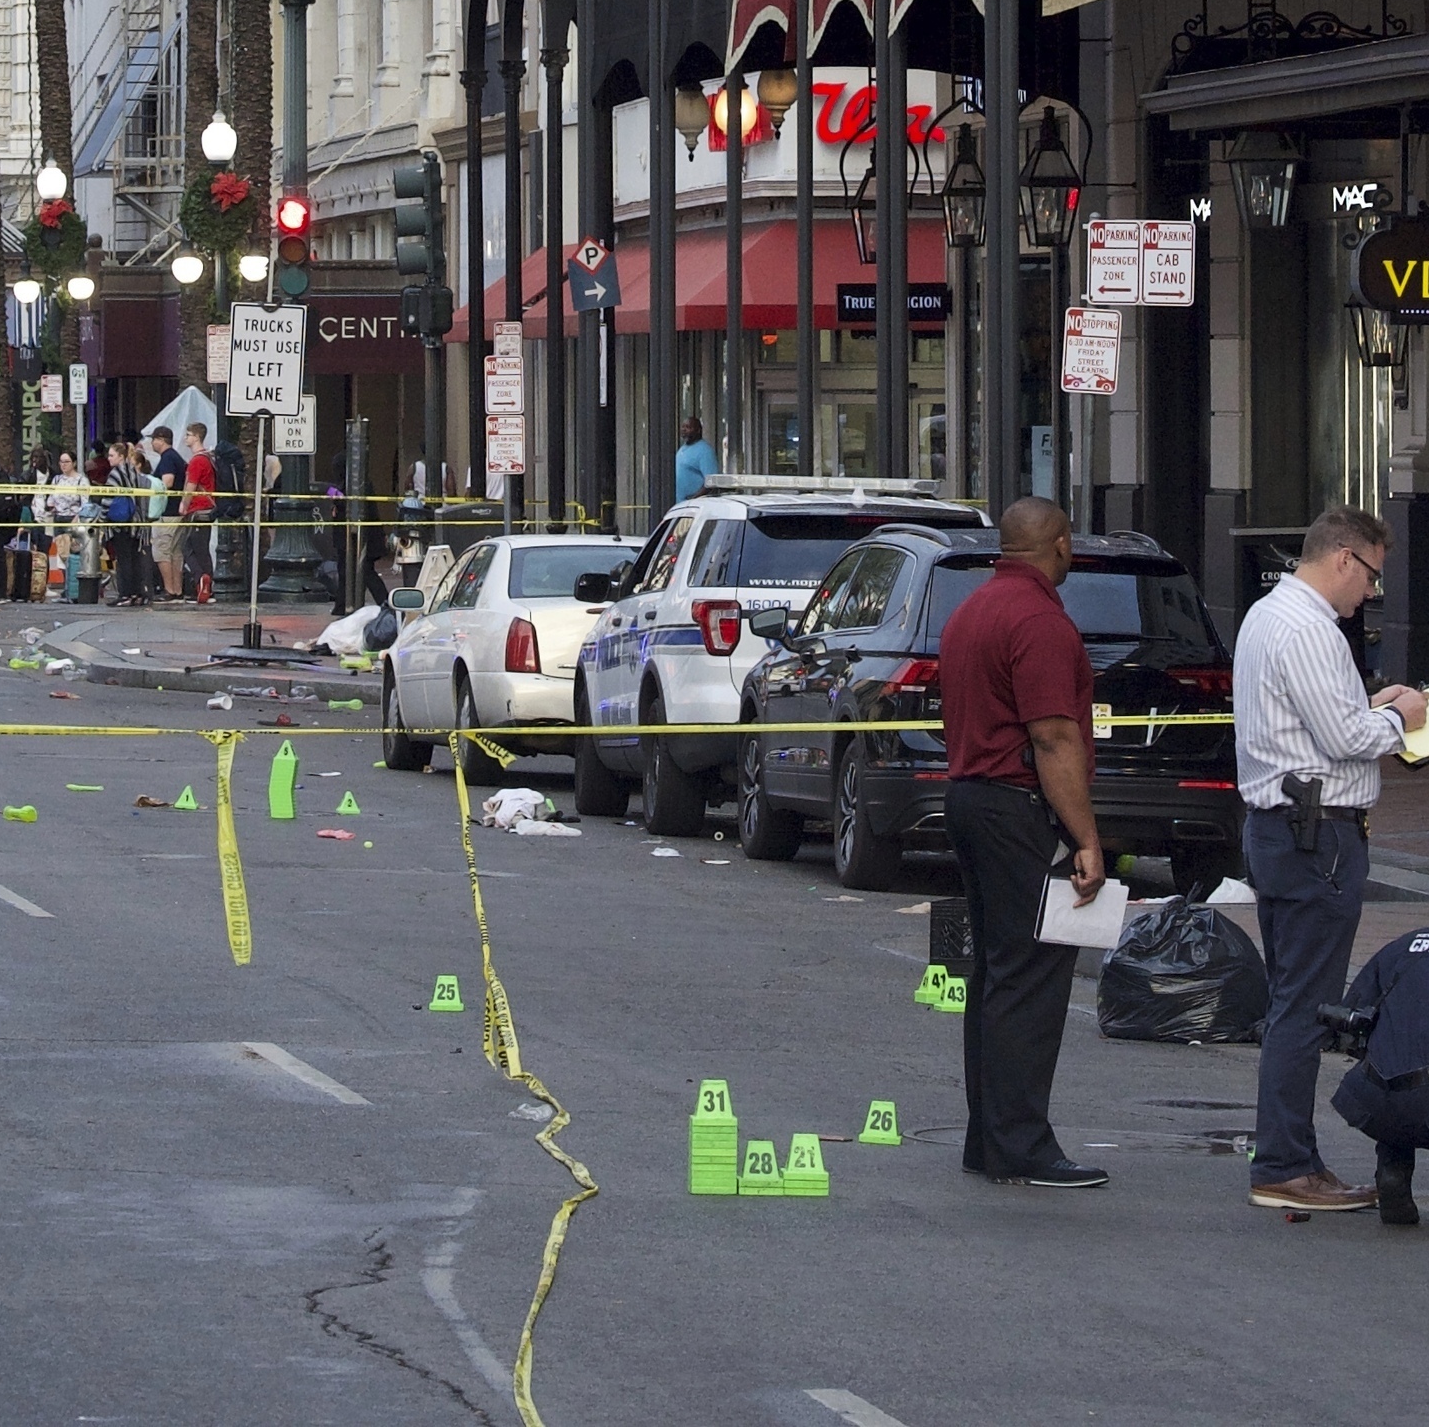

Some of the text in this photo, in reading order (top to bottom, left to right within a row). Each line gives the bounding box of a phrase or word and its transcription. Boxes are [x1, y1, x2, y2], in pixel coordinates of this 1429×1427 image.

[1332, 183, 1378, 213] MAC
[1090, 228, 1139, 243] NO PARKING
[1143, 228, 1192, 244] NO PARKING
[585, 246, 599, 264] P
[1092, 256, 1137, 265] PASSENGER
[1156, 254, 1179, 267] CAB
[1103, 272, 1125, 281] ZONE
[1150, 272, 1186, 285] STAND
[843, 295, 942, 309] TRUE IGION
[244, 319, 293, 333] TRUCKS
[1067, 315, 1118, 331] NO STOPPING
[233, 339, 301, 354] MUST USE
[1068, 338, 1084, 347] 6:30
[1077, 349, 1106, 357] FRIDAY
[486, 361, 497, 371] NO
[1078, 358, 1104, 366] STREET
[248, 362, 284, 377] LEFT
[1072, 366, 1109, 375] CLEANING
[246, 387, 283, 402] LANE
[287, 428, 302, 436] ON
[285, 439, 304, 447] RED
[1261, 571, 1280, 581] CRO
[746, 599, 792, 611] 16004
[932, 973, 946, 989] 41
[437, 984, 456, 1001] 25
[947, 986, 965, 1003] 43
[703, 1090, 725, 1112] 31
[869, 1110, 893, 1131] 26
[748, 1152, 773, 1174] 28
